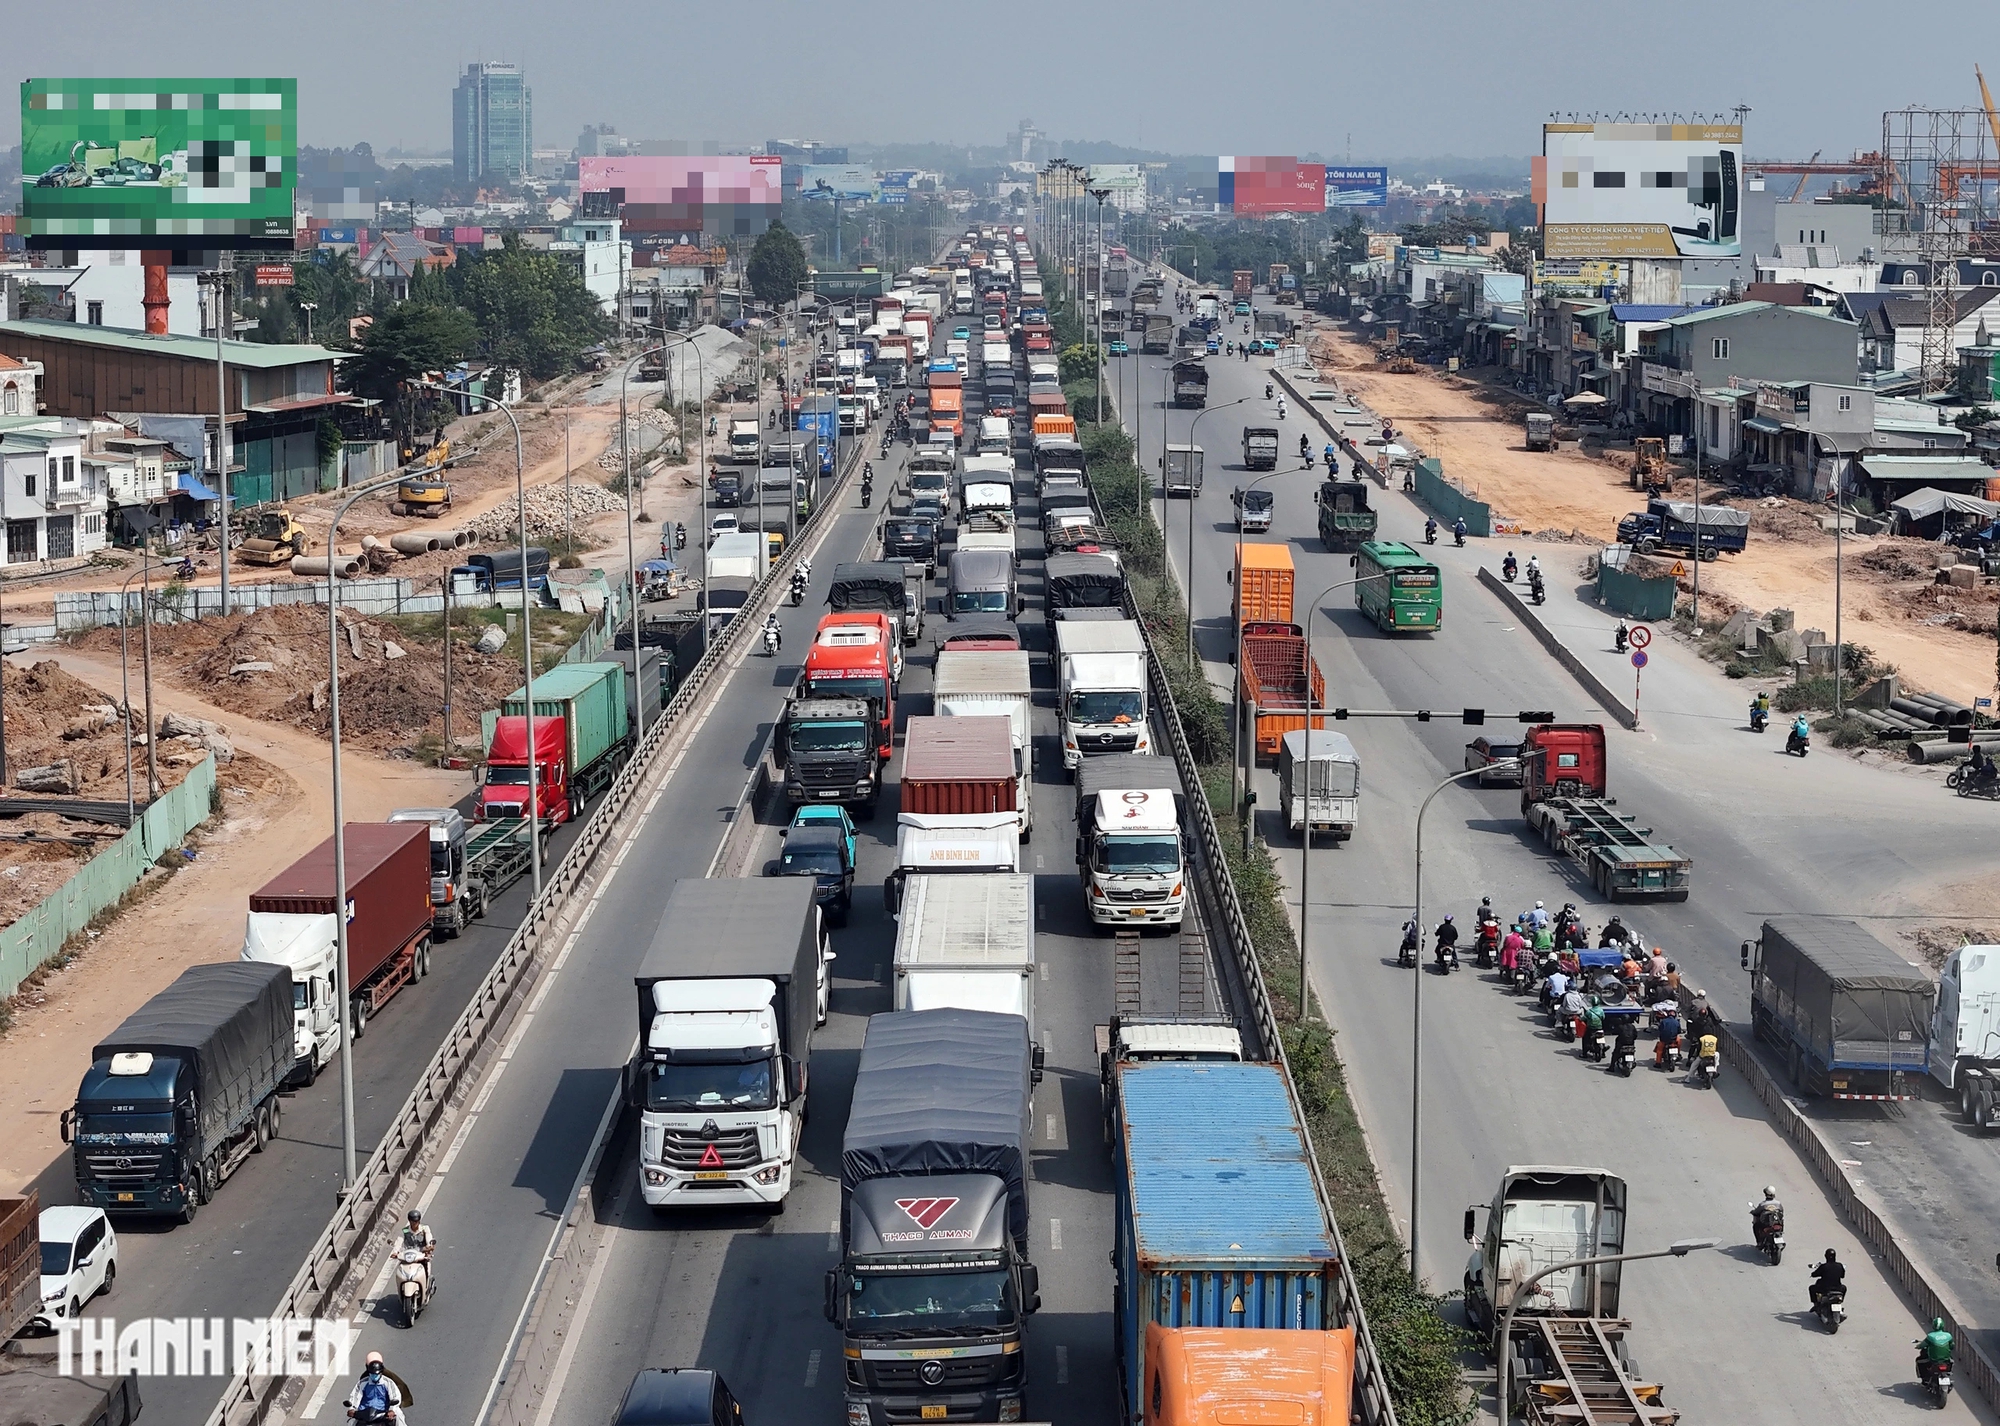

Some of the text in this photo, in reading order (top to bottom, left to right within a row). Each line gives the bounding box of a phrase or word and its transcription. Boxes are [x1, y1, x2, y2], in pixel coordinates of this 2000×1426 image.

[1580, 225, 1591, 233] CỔ
[1592, 225, 1612, 233] PHẦN
[964, 850, 980, 861] LINH
[1704, 1039, 1715, 1047] be
[882, 1229, 973, 1242] THACO AUMAN
